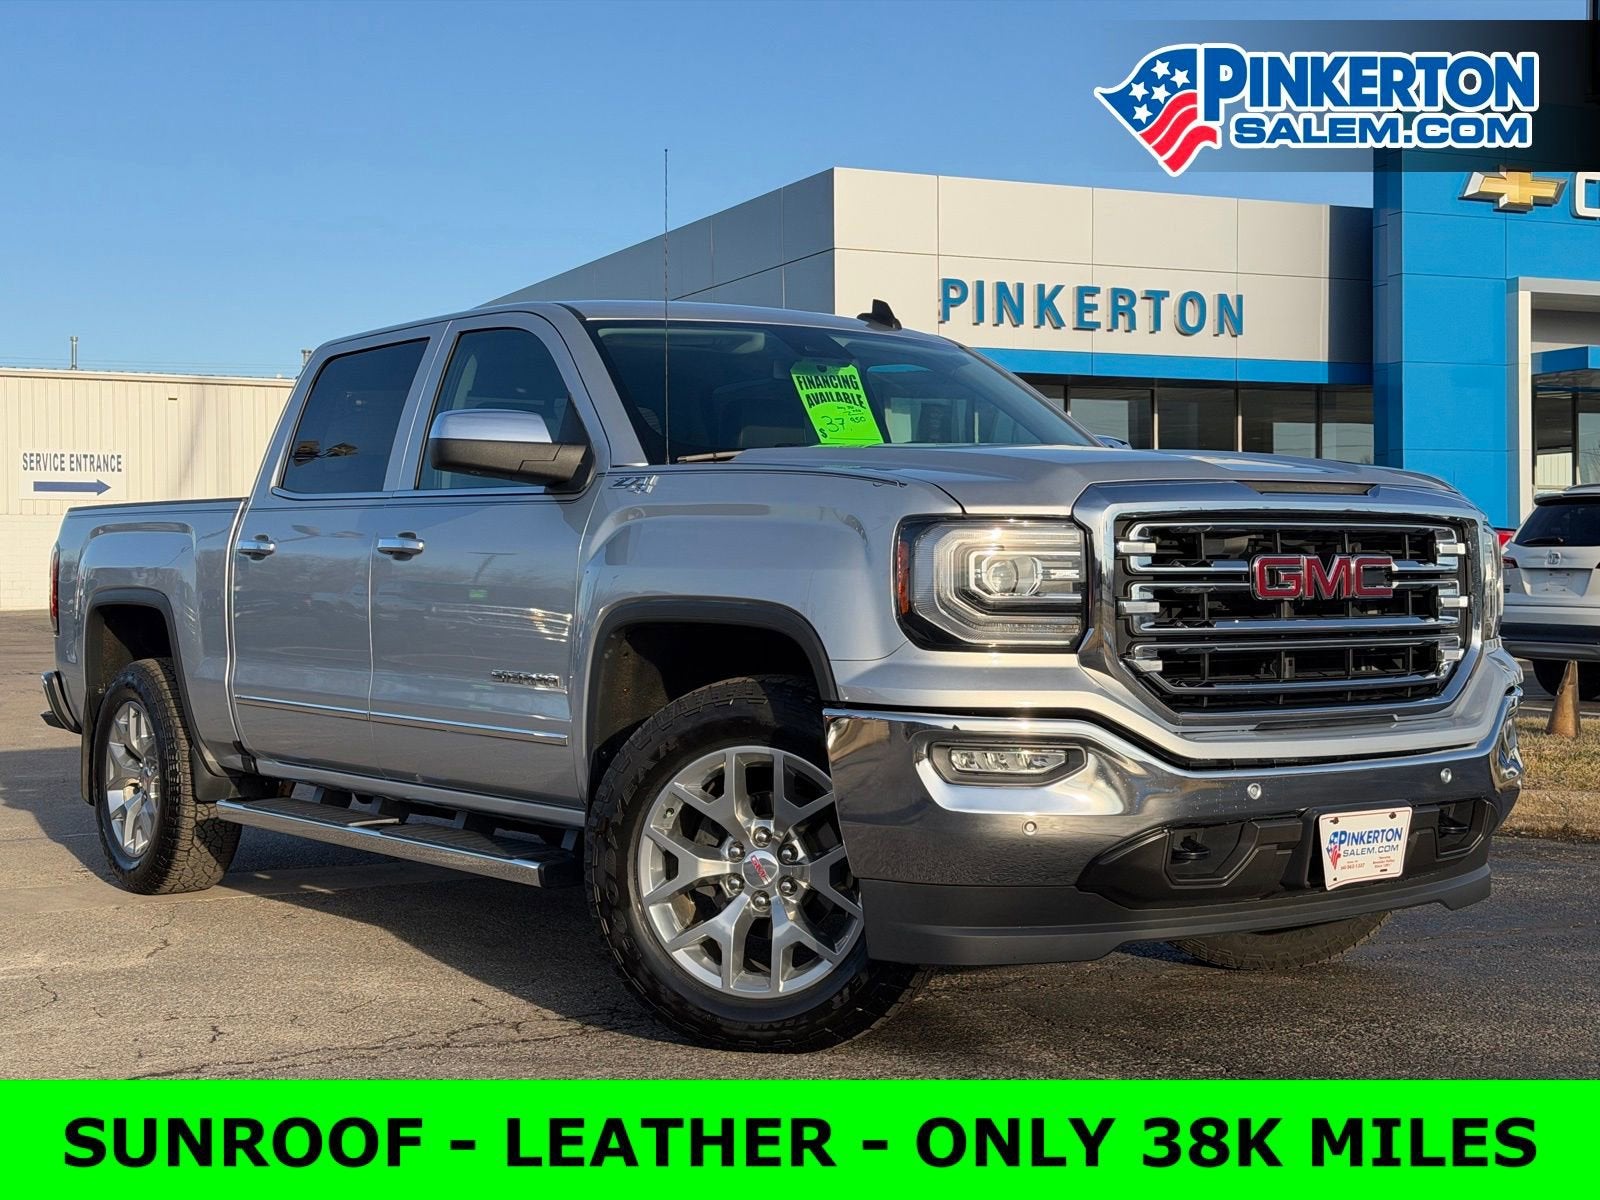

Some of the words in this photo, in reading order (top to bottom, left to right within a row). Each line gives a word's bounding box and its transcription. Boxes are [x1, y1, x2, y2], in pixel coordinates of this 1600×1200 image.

[939, 277, 1244, 336] PINKERTON
[796, 374, 860, 391] FINANCING
[805, 391, 867, 410] AVAILABLE
[22, 452, 66, 471] SERVICE
[69, 453, 122, 472] ENTRANCE
[1252, 554, 1393, 600] GMC
[1338, 827, 1404, 851] PINKERTON
[1342, 844, 1399, 858] SALEM.COM
